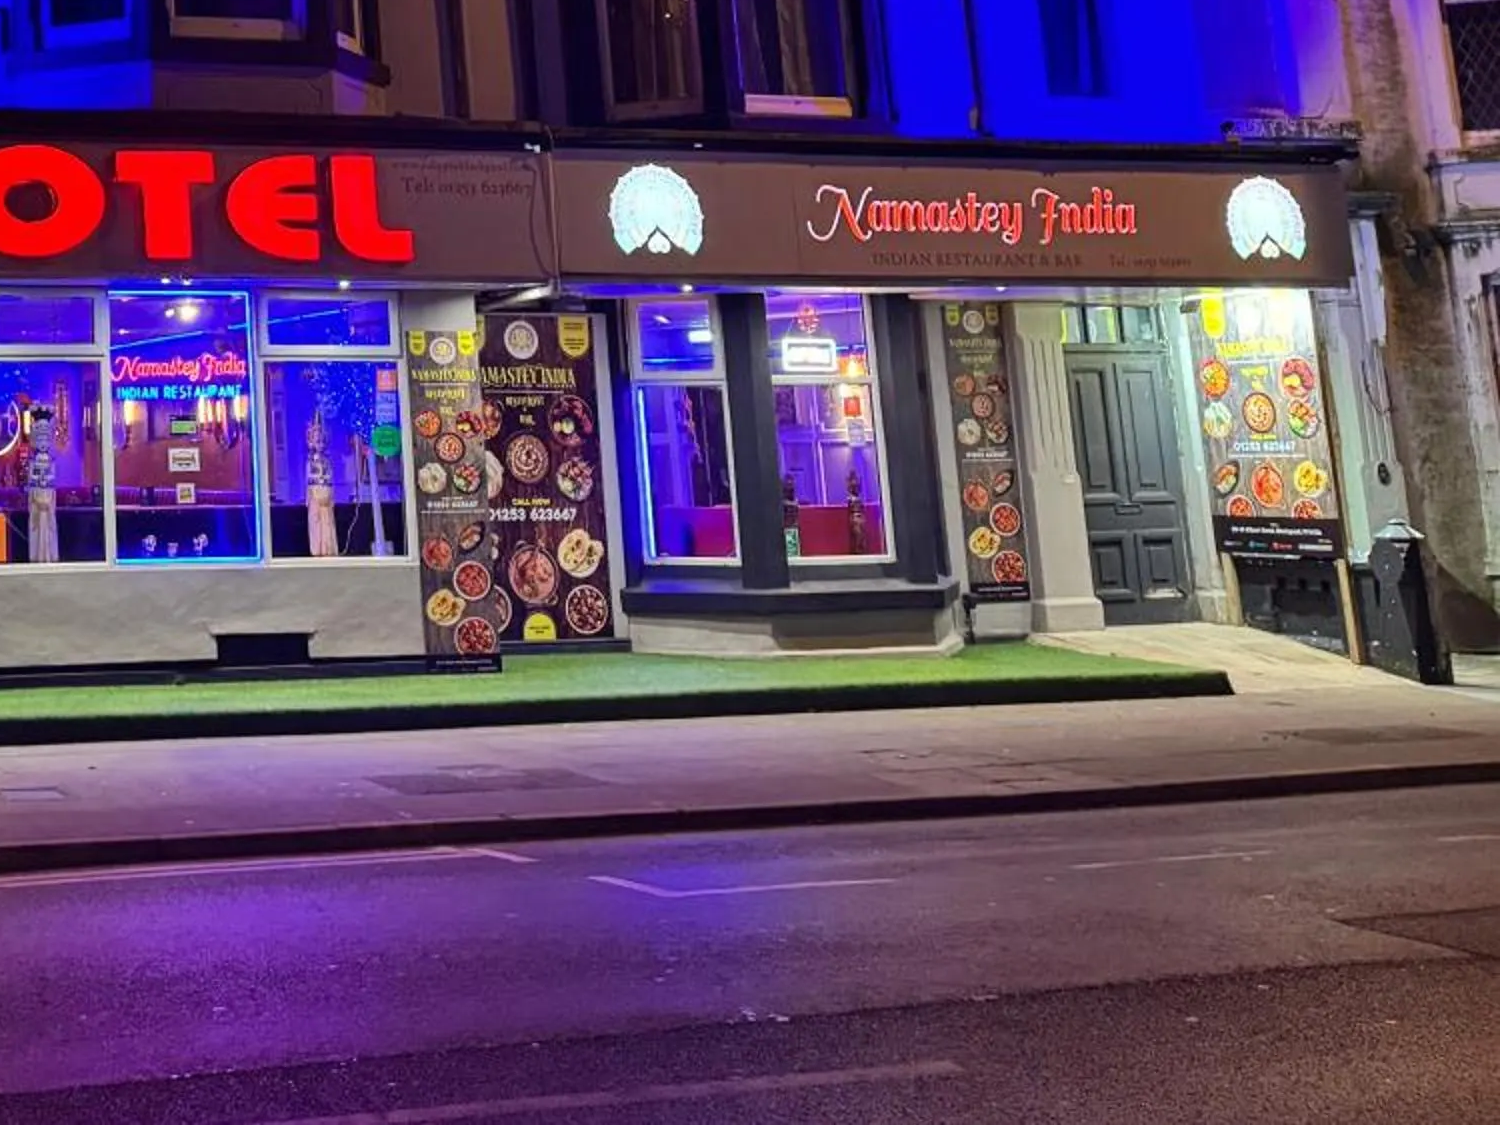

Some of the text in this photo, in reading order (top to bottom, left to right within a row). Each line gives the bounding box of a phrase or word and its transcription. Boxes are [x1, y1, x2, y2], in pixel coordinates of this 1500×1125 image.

[807, 184, 1137, 246] Namastey India
[872, 251, 932, 267] INDIAN
[935, 252, 1035, 268] RESTAURANT
[1054, 254, 1083, 269] BAR
[111, 351, 246, 382] Namastey India
[116, 386, 159, 400] INDIAN
[529, 508, 578, 522] 623667
